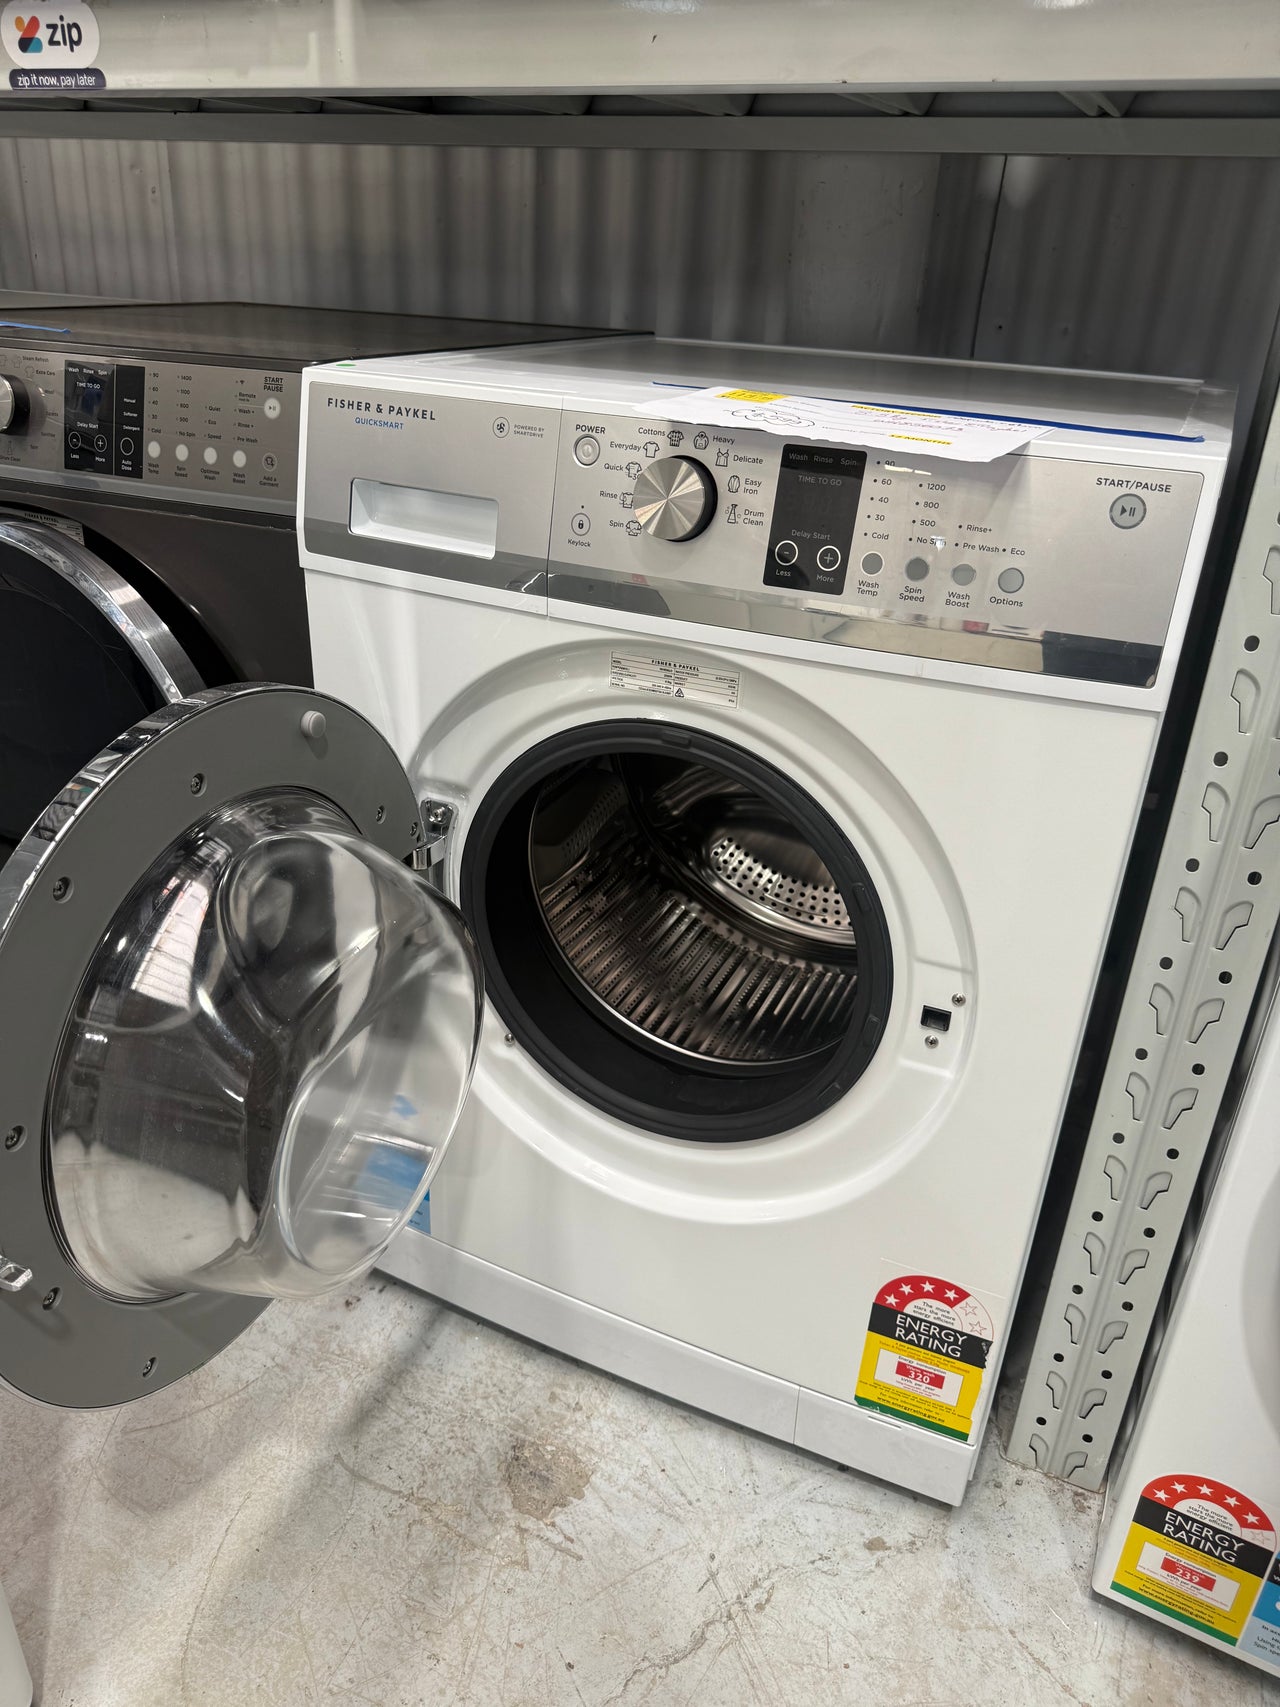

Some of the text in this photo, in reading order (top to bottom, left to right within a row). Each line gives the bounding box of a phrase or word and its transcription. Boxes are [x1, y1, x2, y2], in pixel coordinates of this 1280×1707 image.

[46, 15, 82, 53] zip
[17, 74, 30, 88] zip
[30, 74, 38, 86] it
[60, 76, 76, 88] pay
[76, 74, 96, 86] later
[264, 376, 284, 384] START
[263, 385, 284, 393] PAUSE
[327, 397, 436, 421] FISHER & PAYKEL
[77, 421, 88, 429] Delay
[354, 416, 405, 430] QUICKSMART
[514, 424, 538, 432] POWERED
[513, 430, 544, 438] SMARTDRIVE
[575, 424, 606, 435] POWER
[638, 427, 666, 437] Cottons
[712, 435, 735, 445] Heavy
[609, 441, 642, 452] Everyday
[733, 454, 764, 465] Delicate
[789, 452, 857, 467] Wash Rinse Spin
[604, 463, 624, 472] Quick
[744, 478, 762, 488] Easy
[798, 475, 842, 486] TIME TO GO
[881, 478, 892, 486] 60
[1096, 477, 1172, 493] START/PAUSE
[743, 487, 758, 495] Iron
[926, 483, 946, 492] 1200
[600, 490, 618, 500] Rinse
[878, 496, 889, 504] 40
[923, 501, 940, 510] 800
[744, 509, 764, 518] Drum
[874, 514, 885, 522] 30
[609, 520, 624, 529] Spin
[742, 517, 764, 526] Clean
[920, 519, 936, 528] 500
[966, 524, 993, 534] Rinse+
[791, 529, 831, 541] Delay Start
[871, 532, 890, 540] Cold
[567, 538, 592, 548] Keylock
[916, 536, 928, 545] No
[963, 543, 1000, 554] Pre Wash
[1010, 548, 1026, 556] Eco
[775, 568, 791, 577] Less
[816, 574, 834, 583] More
[858, 579, 880, 589] Wash
[857, 587, 878, 598] Temp
[904, 586, 922, 595] Spin
[899, 593, 925, 603] Speed
[948, 591, 971, 601] Wash
[945, 599, 970, 609] Boost
[989, 596, 1024, 608] Options
[652, 659, 672, 667] FISHER
[678, 664, 700, 672] PAYKEL
[913, 1304, 927, 1313] stars
[940, 1313, 956, 1321] more
[923, 1301, 950, 1315] The more
[912, 1309, 955, 1326] energy efficient
[895, 1313, 968, 1345] ENERGY
[895, 1326, 962, 1358] RATING
[898, 1356, 914, 1365] Energy
[901, 1377, 913, 1385] kWh
[908, 1370, 930, 1384] 320
[1188, 1505, 1234, 1527] stars the more
[1197, 1503, 1228, 1520] The more
[1186, 1509, 1233, 1532] energy efficient
[1165, 1511, 1245, 1551] ENERGY
[1163, 1524, 1238, 1563] RATING
[1165, 1552, 1182, 1563] Energy
[1166, 1573, 1181, 1582] kWh
[1180, 1579, 1189, 1587] per
[1174, 1567, 1200, 1583] 239
[1253, 1640, 1268, 1651] Spin
[1257, 1636, 1276, 1649] Using
